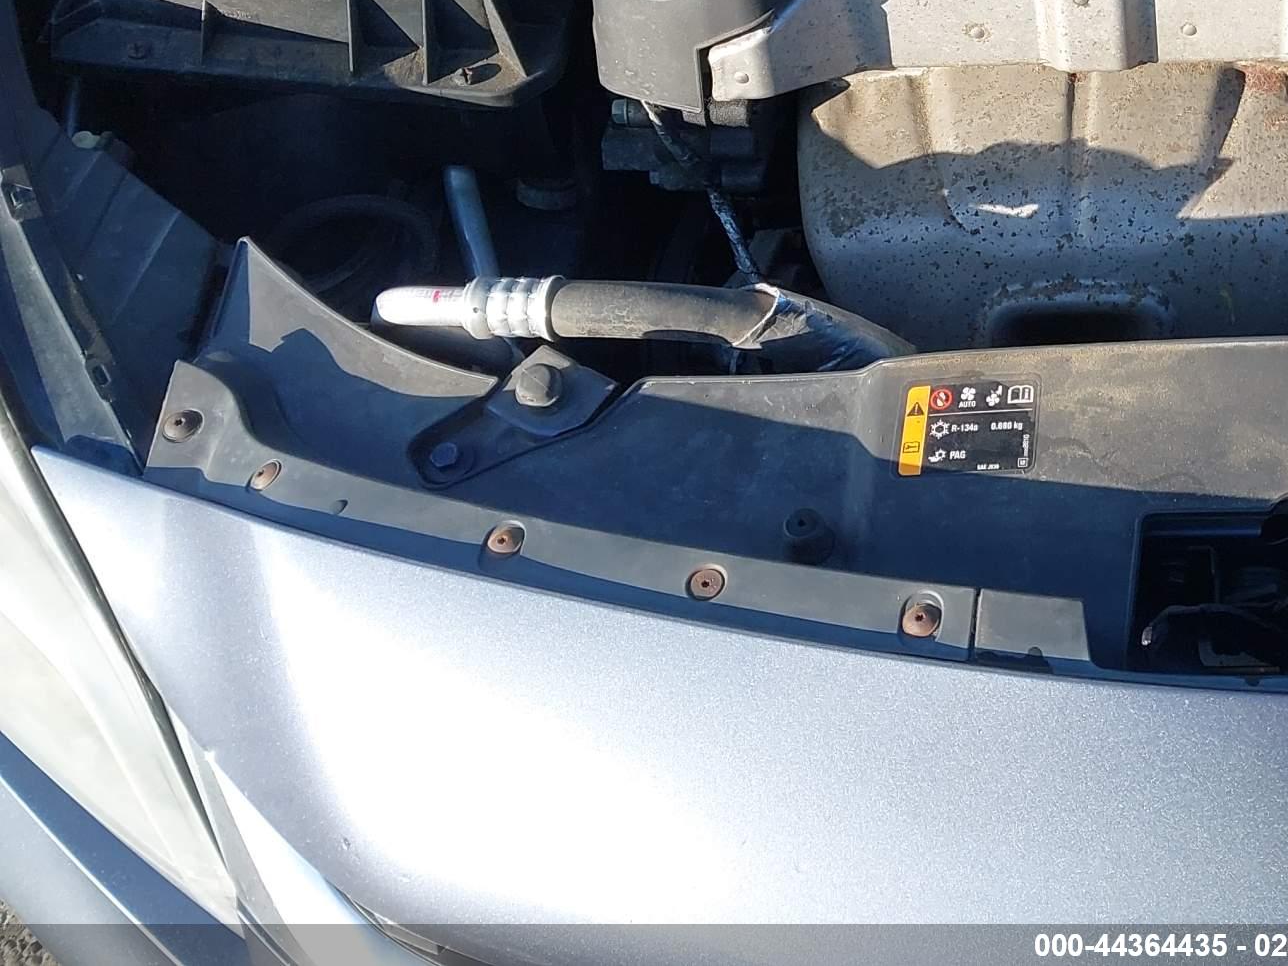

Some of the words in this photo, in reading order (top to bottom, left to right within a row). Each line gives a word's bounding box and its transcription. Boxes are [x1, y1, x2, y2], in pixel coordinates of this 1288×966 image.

[958, 400, 977, 408] AUTO
[951, 423, 979, 432] R-134a
[1013, 420, 1023, 431] kg
[949, 450, 966, 460] PAG
